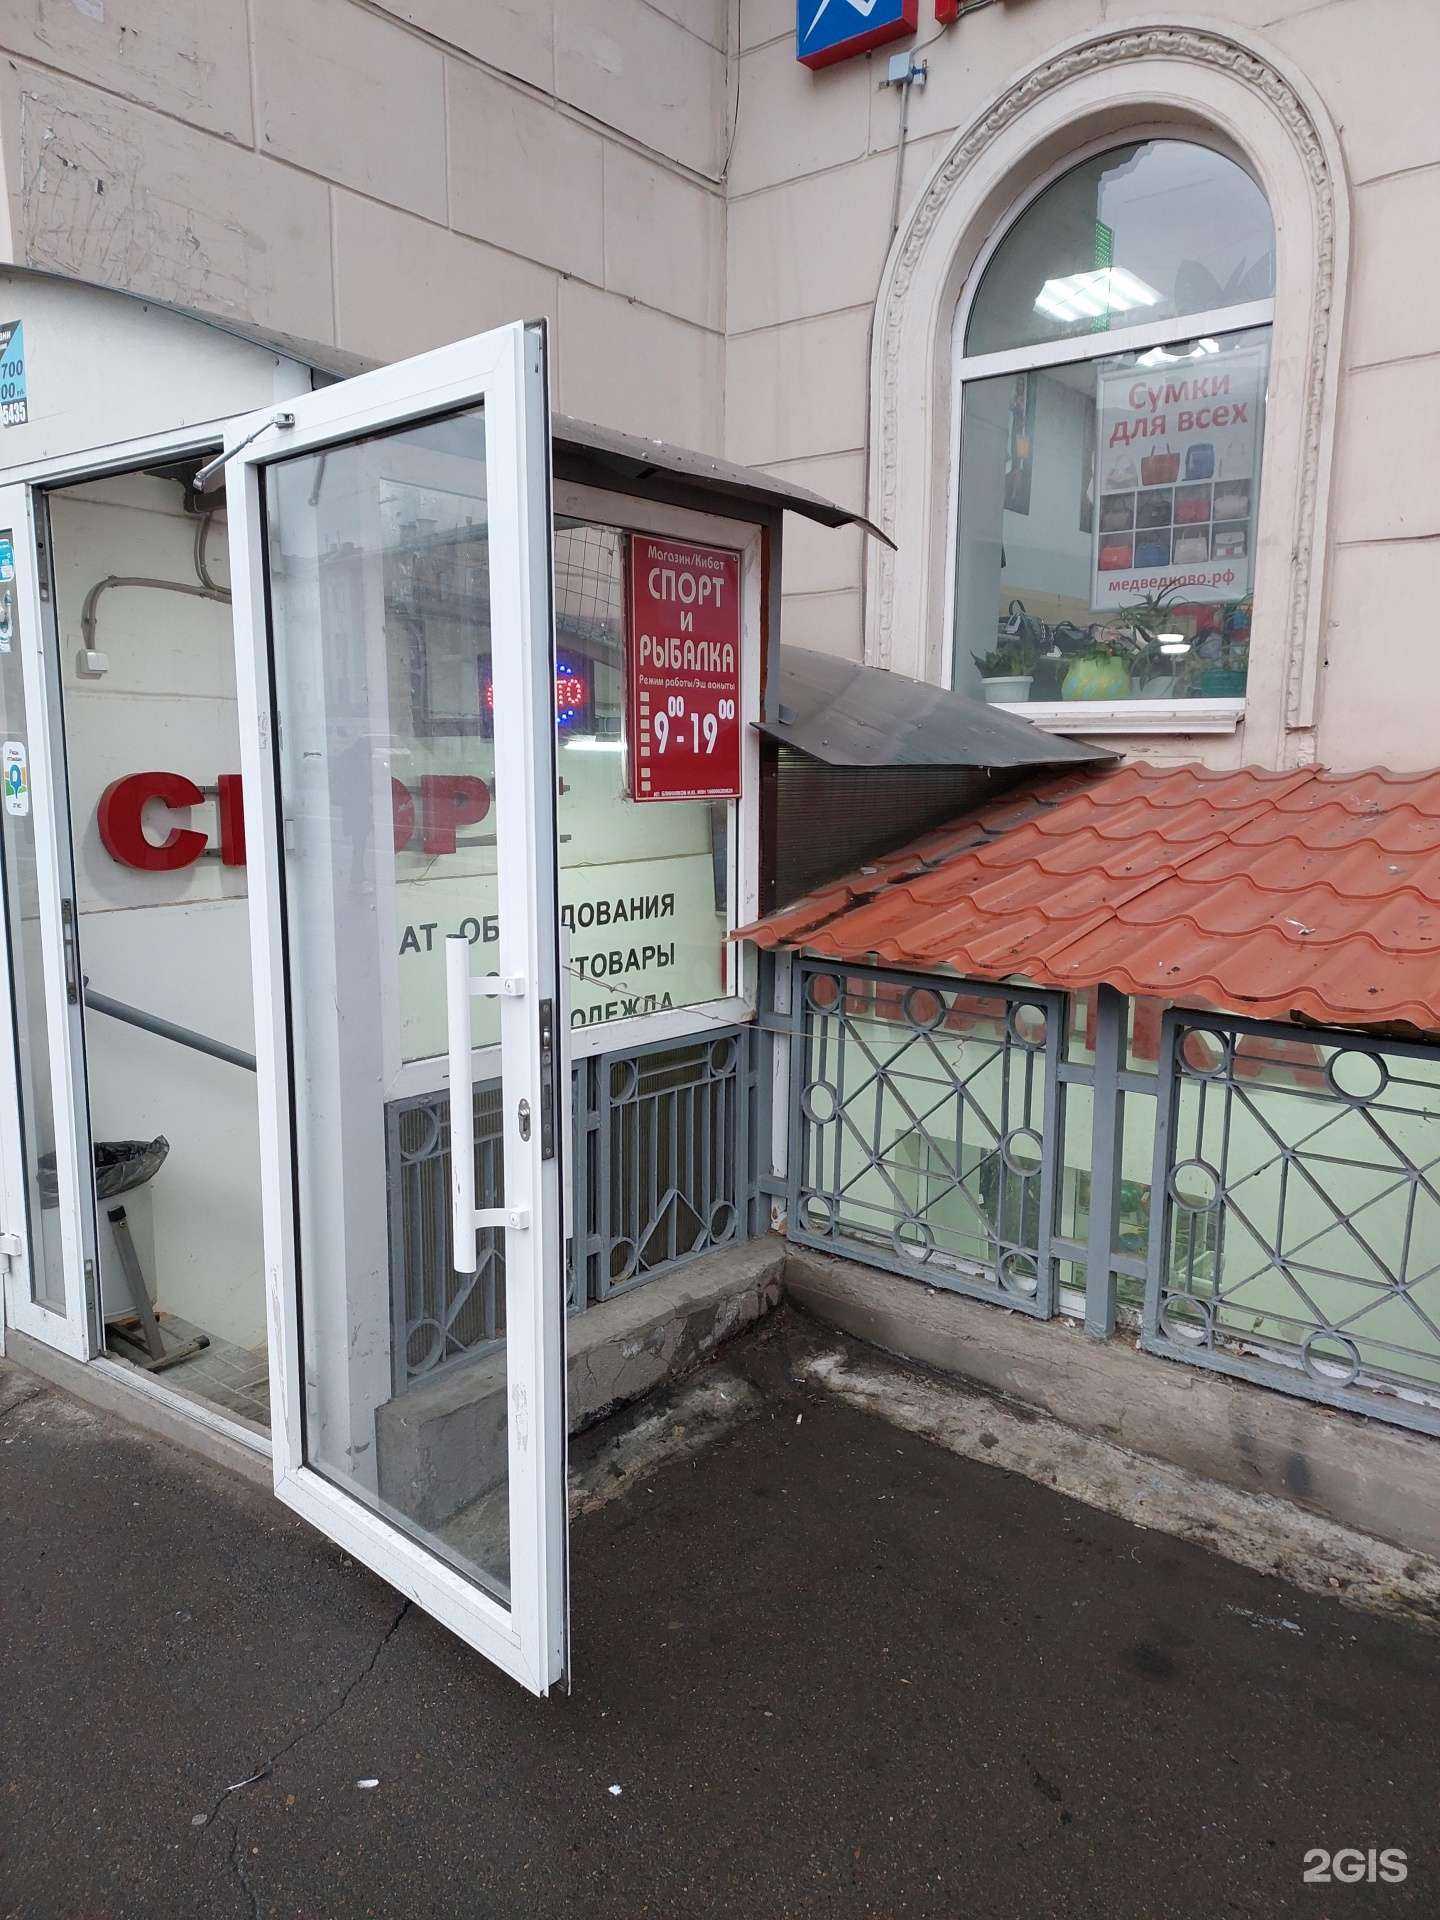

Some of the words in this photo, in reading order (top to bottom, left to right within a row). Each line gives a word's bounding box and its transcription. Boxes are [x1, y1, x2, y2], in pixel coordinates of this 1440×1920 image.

[1129, 374, 1232, 413] Сумки
[1109, 415, 1167, 449] для
[1177, 402, 1249, 433] всех
[648, 567, 725, 608] СПОРТ
[1108, 568, 1235, 593] медведково.рф
[640, 634, 734, 673] РЫБАЛКА
